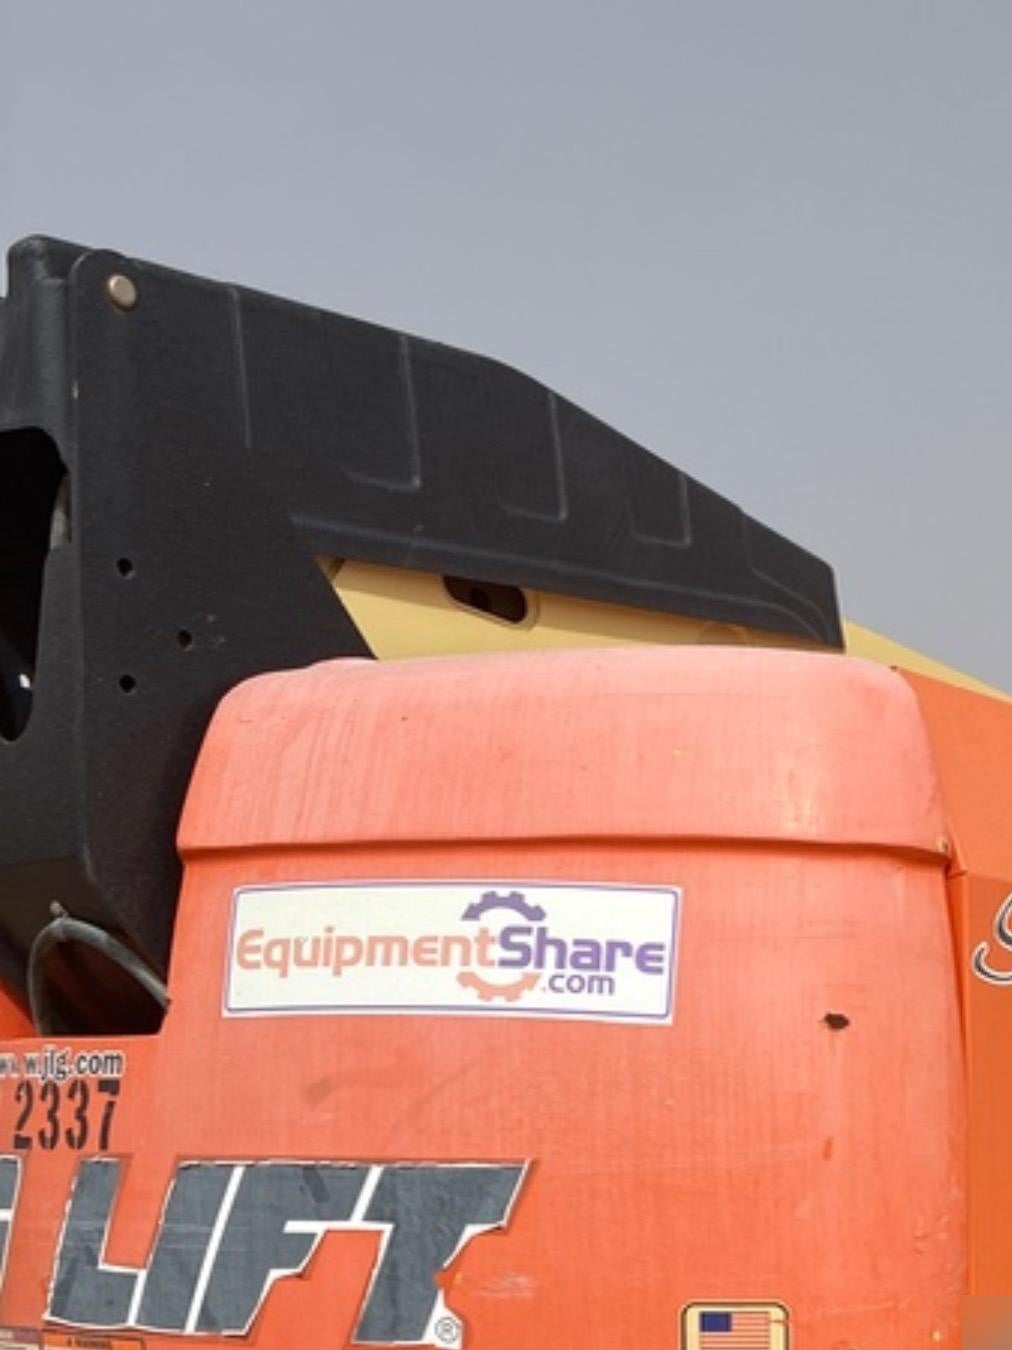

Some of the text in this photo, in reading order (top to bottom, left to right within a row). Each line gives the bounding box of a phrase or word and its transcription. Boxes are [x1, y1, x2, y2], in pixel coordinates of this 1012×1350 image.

[235, 925, 667, 979] EquipmentShare
[541, 973, 616, 996] .com
[13, 1079, 121, 1151] 2337
[43, 1157, 533, 1346] LIFT
